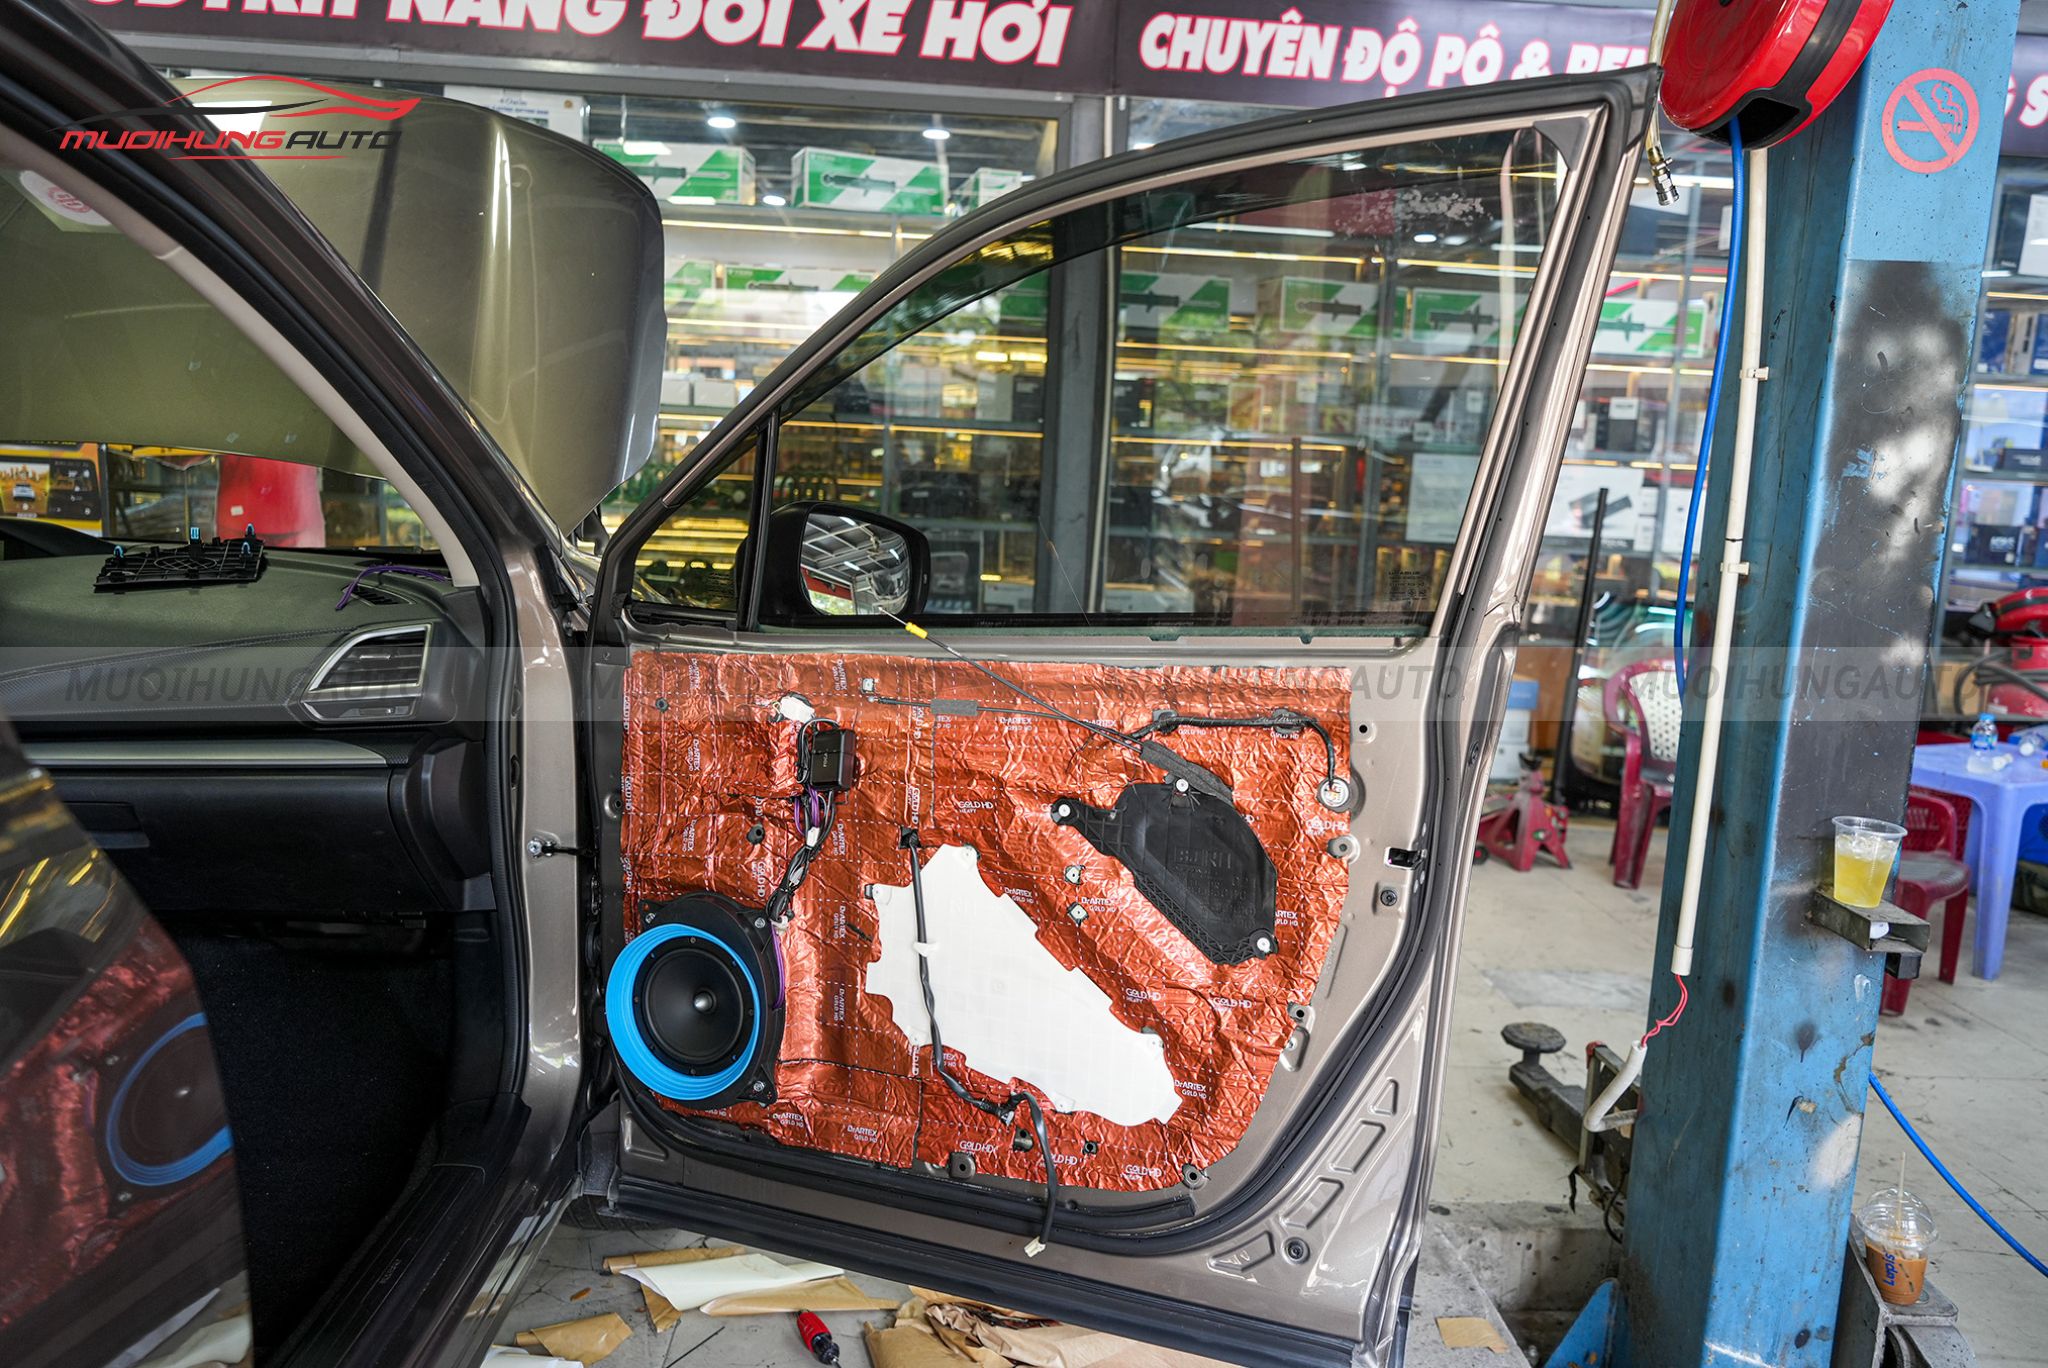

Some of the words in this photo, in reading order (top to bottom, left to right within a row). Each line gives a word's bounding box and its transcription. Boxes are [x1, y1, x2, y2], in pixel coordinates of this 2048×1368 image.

[796, 0, 906, 55] XE
[919, 0, 1074, 67] HƠI
[1139, 6, 1342, 80] CHUYÊN
[1343, 17, 1423, 98] ĐỘ
[1427, 23, 1504, 88] PÔ
[1511, 39, 1552, 81] &
